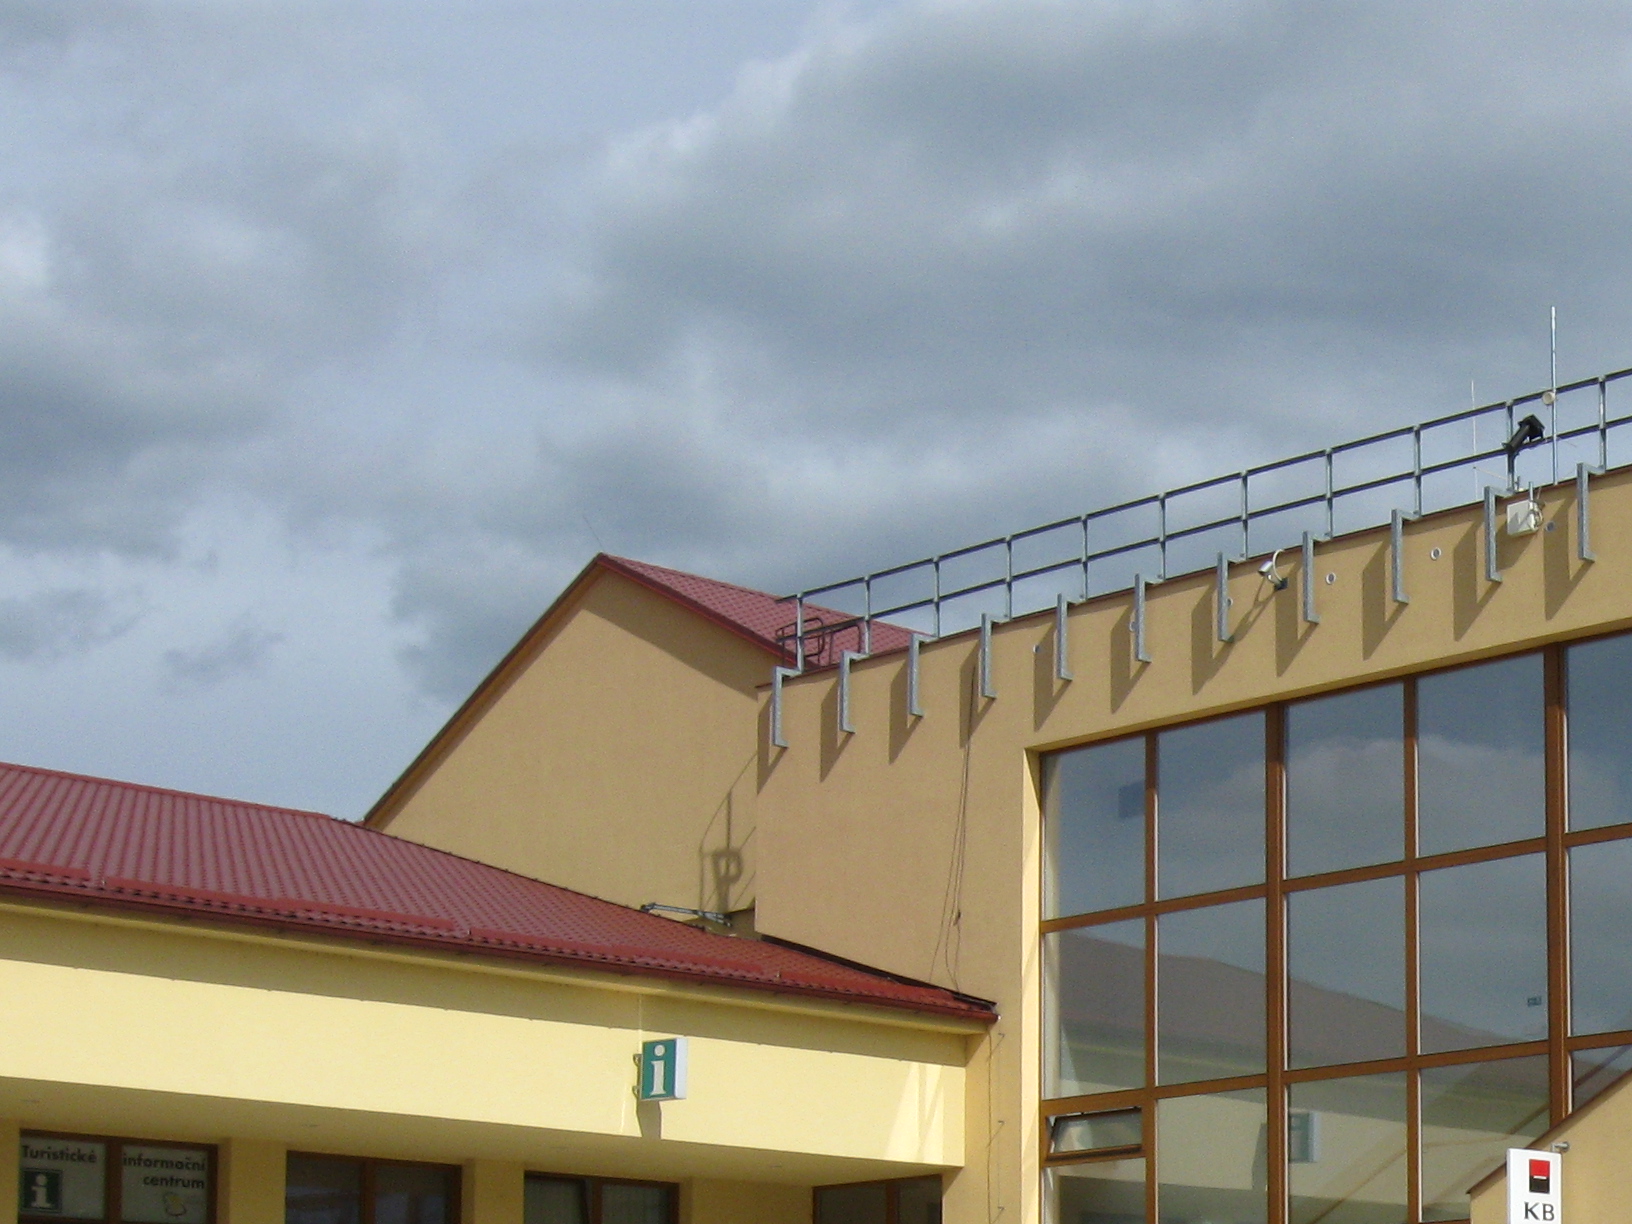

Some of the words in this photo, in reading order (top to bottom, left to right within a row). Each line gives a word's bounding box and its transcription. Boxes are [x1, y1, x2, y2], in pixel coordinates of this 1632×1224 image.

[22, 1145, 97, 1163] Turistické
[123, 1152, 206, 1171] informační
[143, 1174, 205, 1189] centrum
[1524, 1201, 1555, 1221] KB
